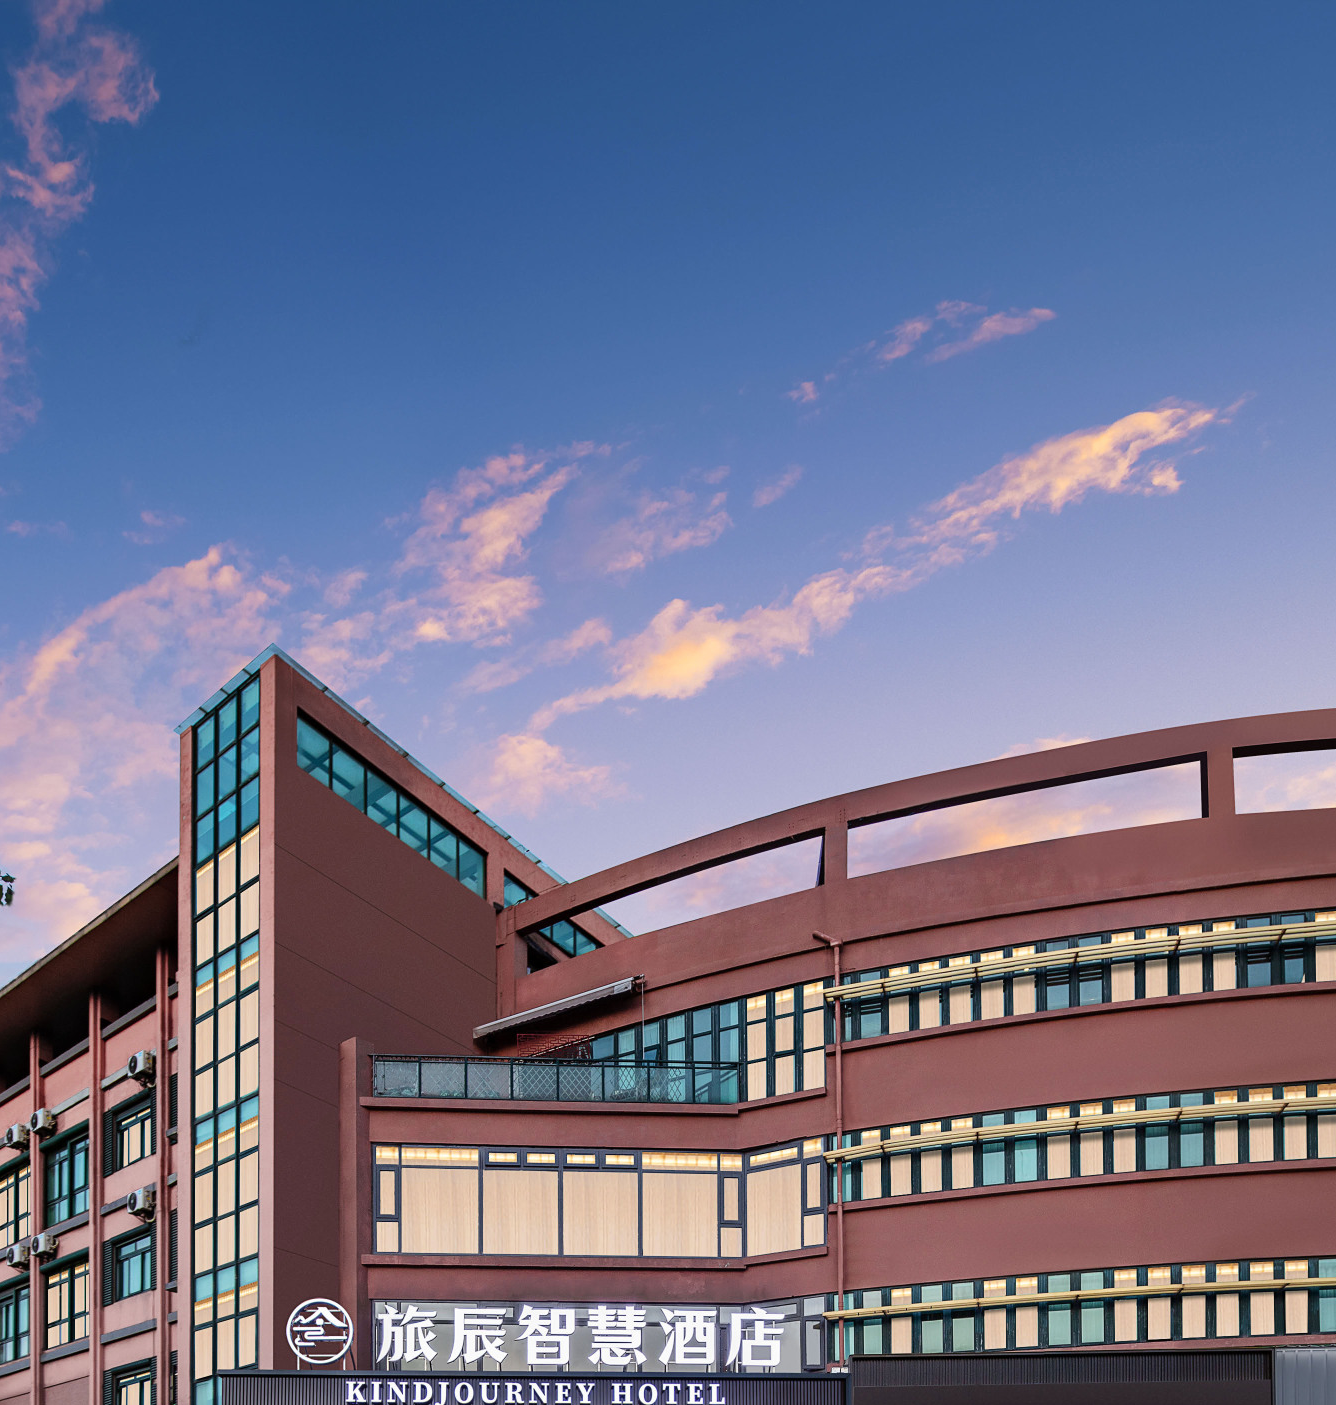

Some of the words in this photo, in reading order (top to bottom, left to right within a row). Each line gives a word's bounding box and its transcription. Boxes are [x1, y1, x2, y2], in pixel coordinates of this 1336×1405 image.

[375, 1304, 785, 1367] 旅辰智慧酒店
[612, 1382, 727, 1405] HOTEL
